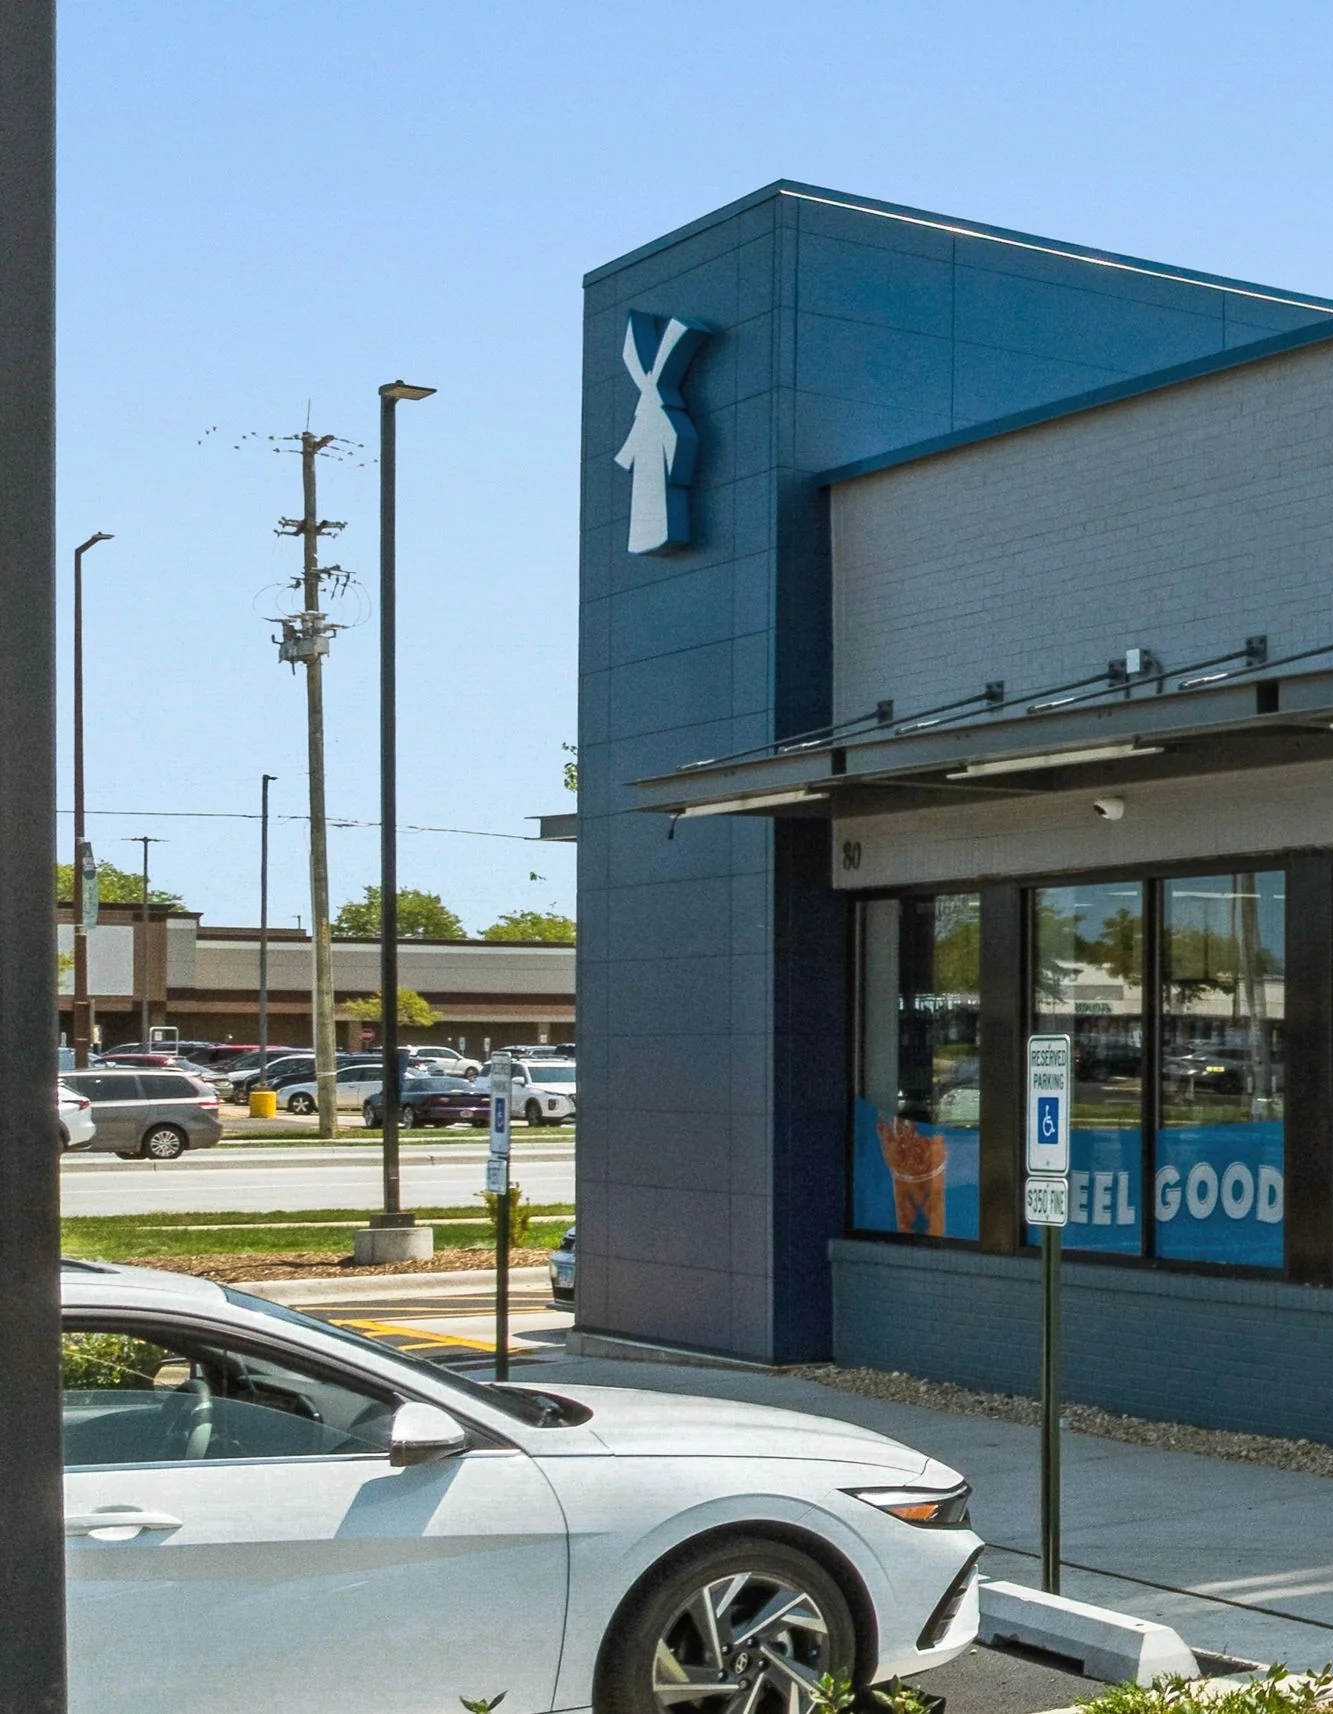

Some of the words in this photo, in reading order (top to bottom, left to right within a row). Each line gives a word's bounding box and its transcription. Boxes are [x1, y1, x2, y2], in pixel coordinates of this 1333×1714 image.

[843, 841, 861, 870] 80
[1031, 1050, 1066, 1067] RESERVED
[1033, 1073, 1064, 1091] PARKING
[1027, 1189, 1048, 1214] $350
[1049, 1190, 1064, 1215] FINE
[1070, 1170, 1136, 1225] EEL
[1155, 1161, 1285, 1224] GOOD
